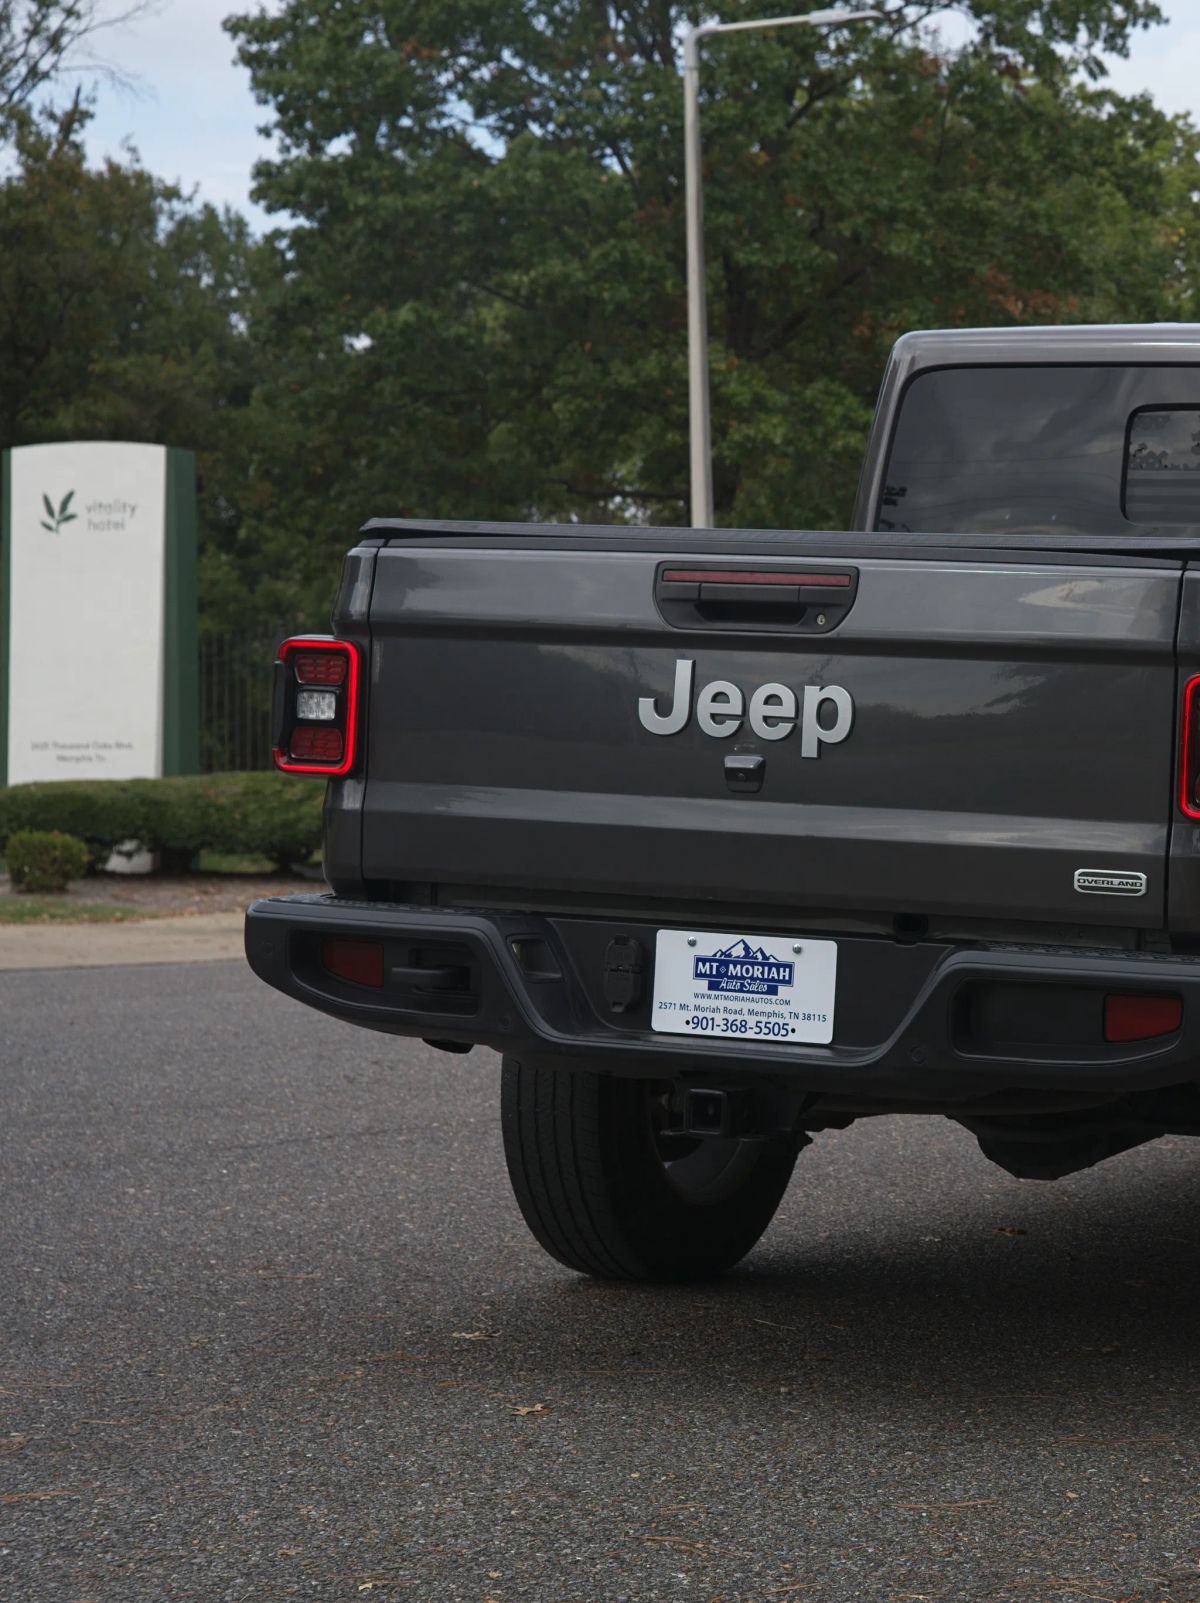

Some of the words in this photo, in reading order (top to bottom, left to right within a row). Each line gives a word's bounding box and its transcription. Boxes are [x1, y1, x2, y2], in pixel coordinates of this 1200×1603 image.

[86, 500, 137, 518] vitality
[88, 519, 126, 531] hotel
[638, 659, 855, 759] Jeep
[1077, 878, 1143, 887] OVERLAND
[697, 961, 719, 975] MT
[728, 964, 790, 980] MORIAH
[719, 978, 741, 990] Auto
[743, 980, 768, 992] Sales
[693, 992, 791, 1006] WWW.MTMORIAHAUTOS.COM
[658, 1002, 677, 1011] 2571
[679, 1003, 691, 1012] Mt.
[694, 1004, 721, 1013] Moriah
[723, 1006, 745, 1016] Road,
[748, 1008, 786, 1019] Memphis,
[788, 1011, 800, 1020] TN
[802, 1012, 827, 1022] 38115
